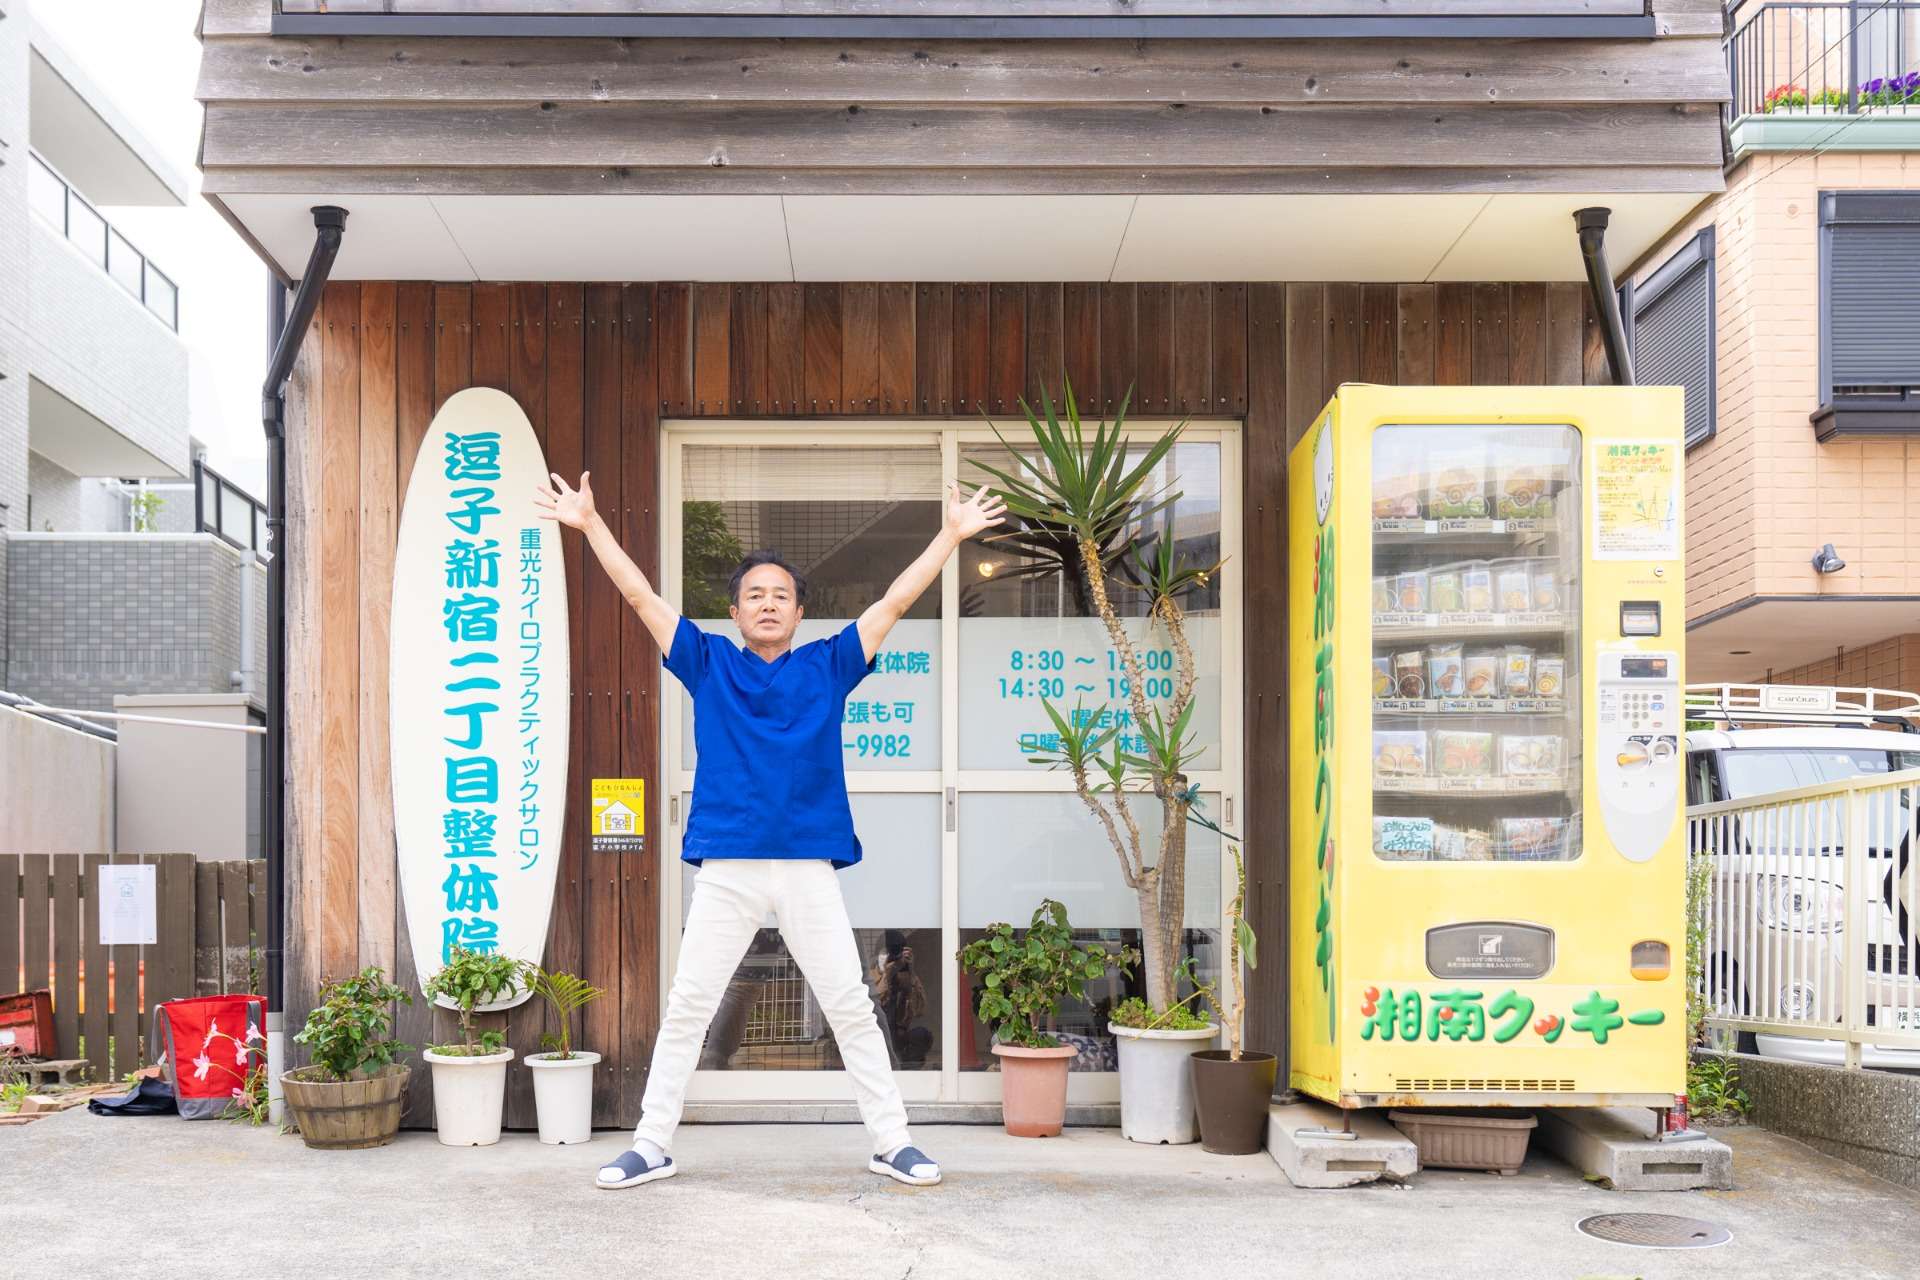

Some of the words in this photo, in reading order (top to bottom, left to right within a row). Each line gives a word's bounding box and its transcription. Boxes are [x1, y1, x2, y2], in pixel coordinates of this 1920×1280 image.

[1011, 650, 1064, 671] 8:30
[1107, 650, 1173, 671] 1:00
[441, 432, 502, 966] 逗子新宿二丁目整体院
[518, 528, 542, 870] 重光カイロプラクティックサロン
[999, 677, 1064, 699] 14:30
[1107, 678, 1173, 699] 1900
[842, 701, 914, 723] 張も可
[1360, 986, 1666, 1045] 湘南クッキー
